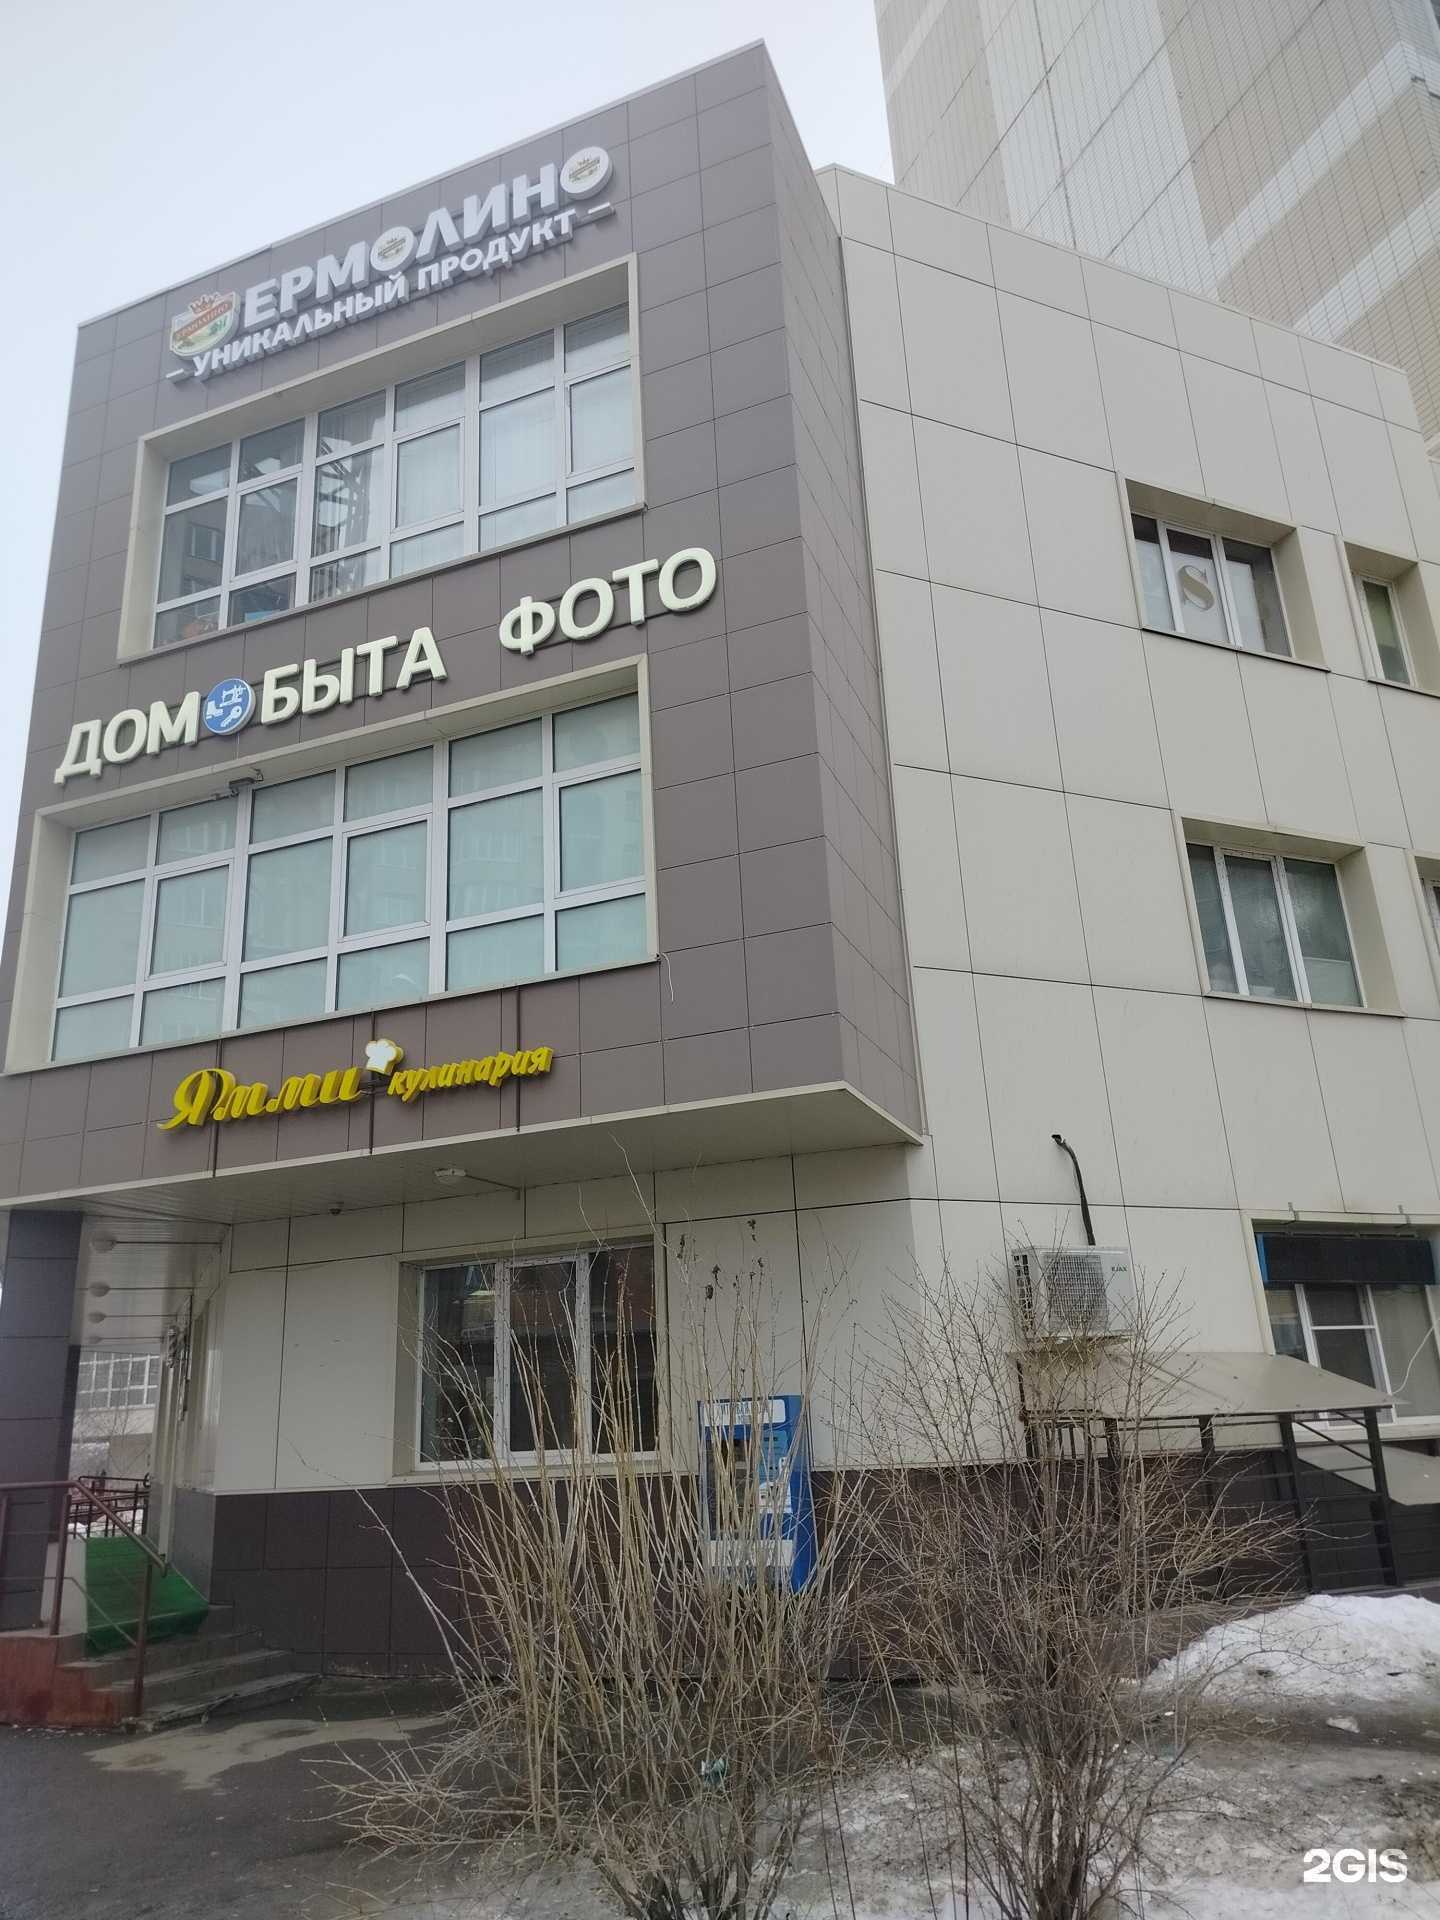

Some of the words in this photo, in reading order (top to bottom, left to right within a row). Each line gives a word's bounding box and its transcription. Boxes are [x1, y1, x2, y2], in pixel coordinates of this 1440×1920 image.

[192, 270, 408, 377] УНИКАЛЬНЫЙ
[418, 209, 576, 290] ПРОДУКТ
[244, 146, 612, 330] ЕРМОЛИНО
[499, 547, 717, 656] ФОТО
[54, 691, 200, 784] ДОМ
[260, 627, 447, 726] БЫТА
[387, 1046, 553, 1102] кулинария
